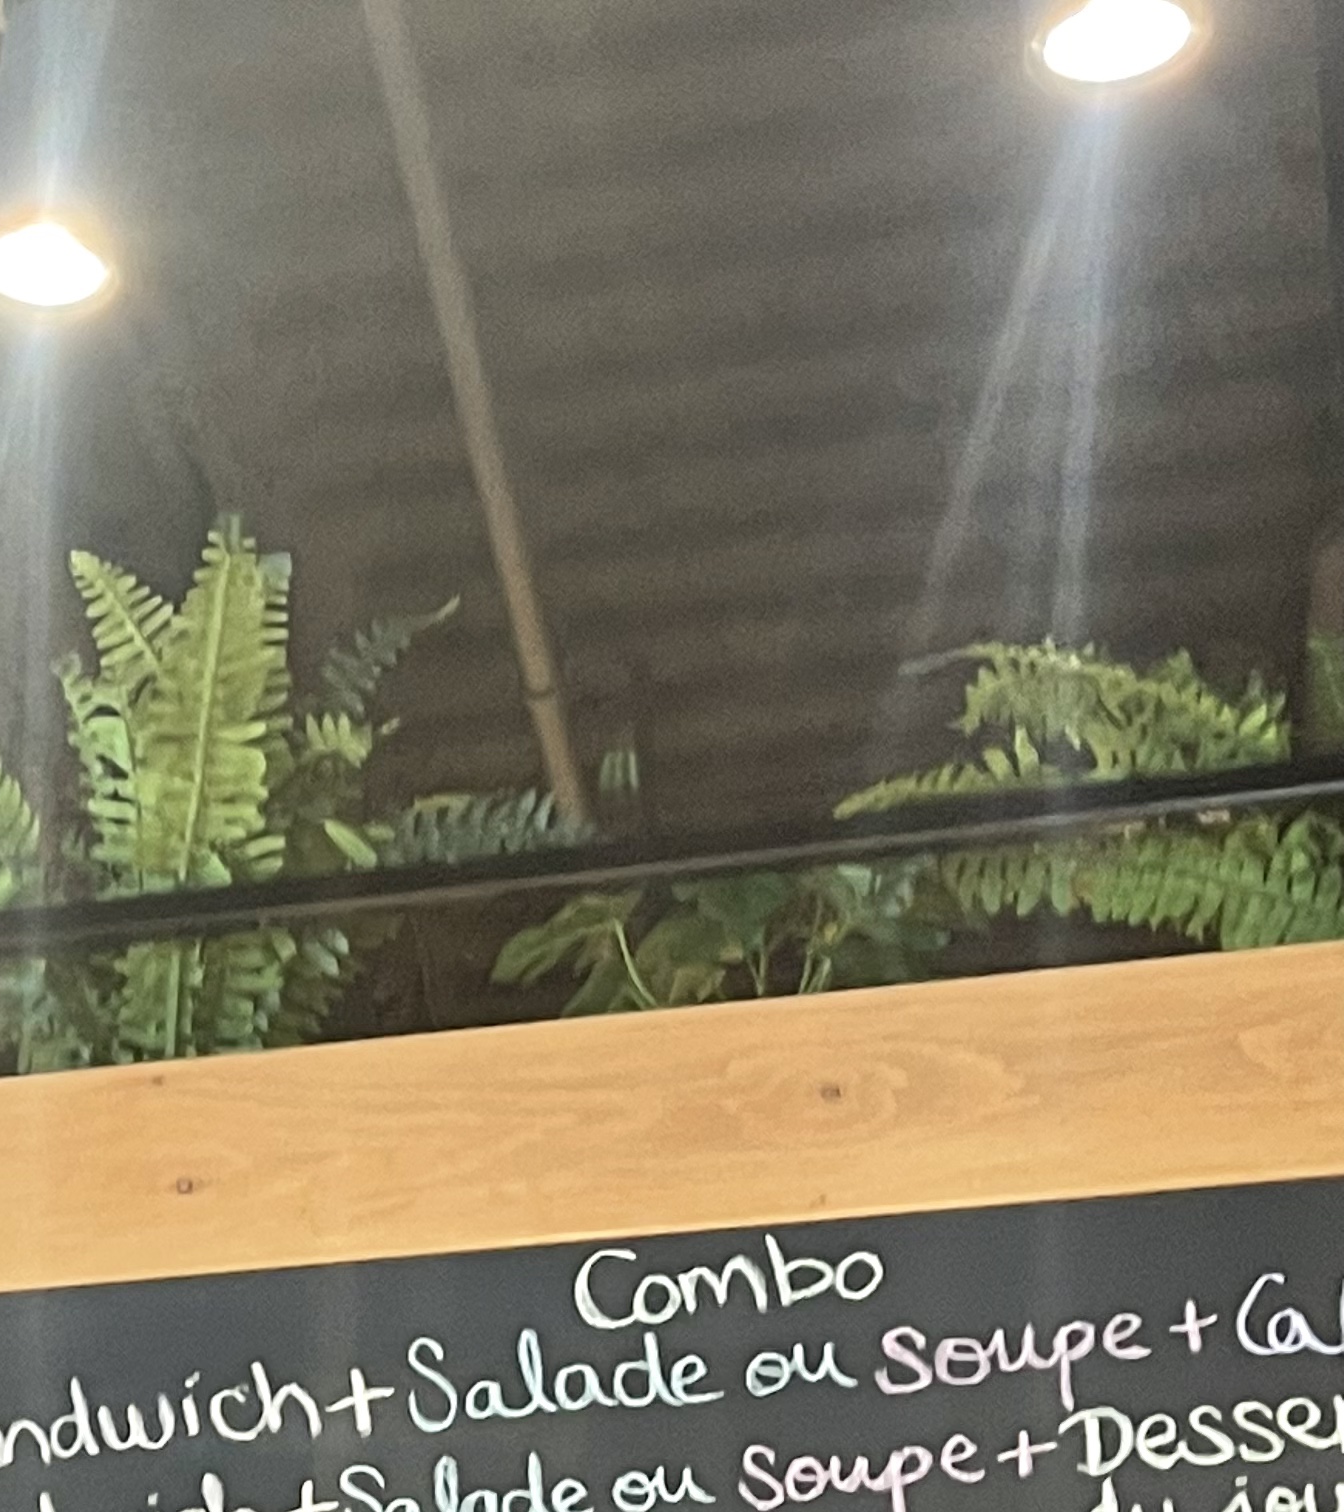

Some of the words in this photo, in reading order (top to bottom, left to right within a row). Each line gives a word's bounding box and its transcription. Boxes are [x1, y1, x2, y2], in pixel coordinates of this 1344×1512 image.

[573, 1234, 884, 1330] Combo
[407, 1328, 724, 1433] Salade
[745, 1340, 858, 1397] ou
[1234, 1272, 1344, 1357] Ca
